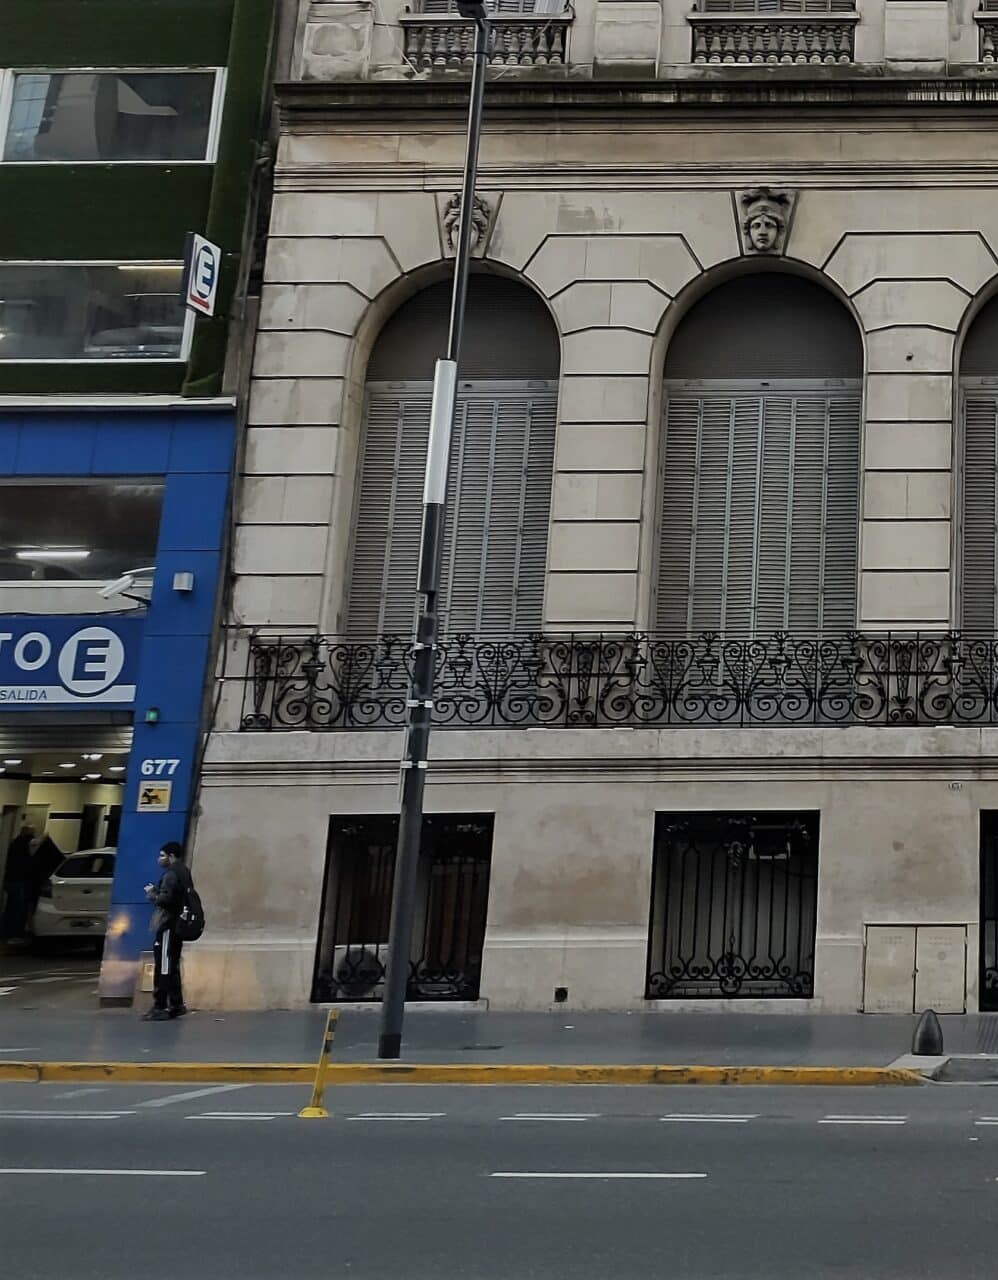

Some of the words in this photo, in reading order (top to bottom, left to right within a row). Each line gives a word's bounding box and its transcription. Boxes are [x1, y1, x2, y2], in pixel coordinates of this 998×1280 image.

[197, 249, 214, 297] E
[71, 639, 111, 681] E
[0, 689, 48, 701] SALIDA
[141, 759, 180, 775] 677
